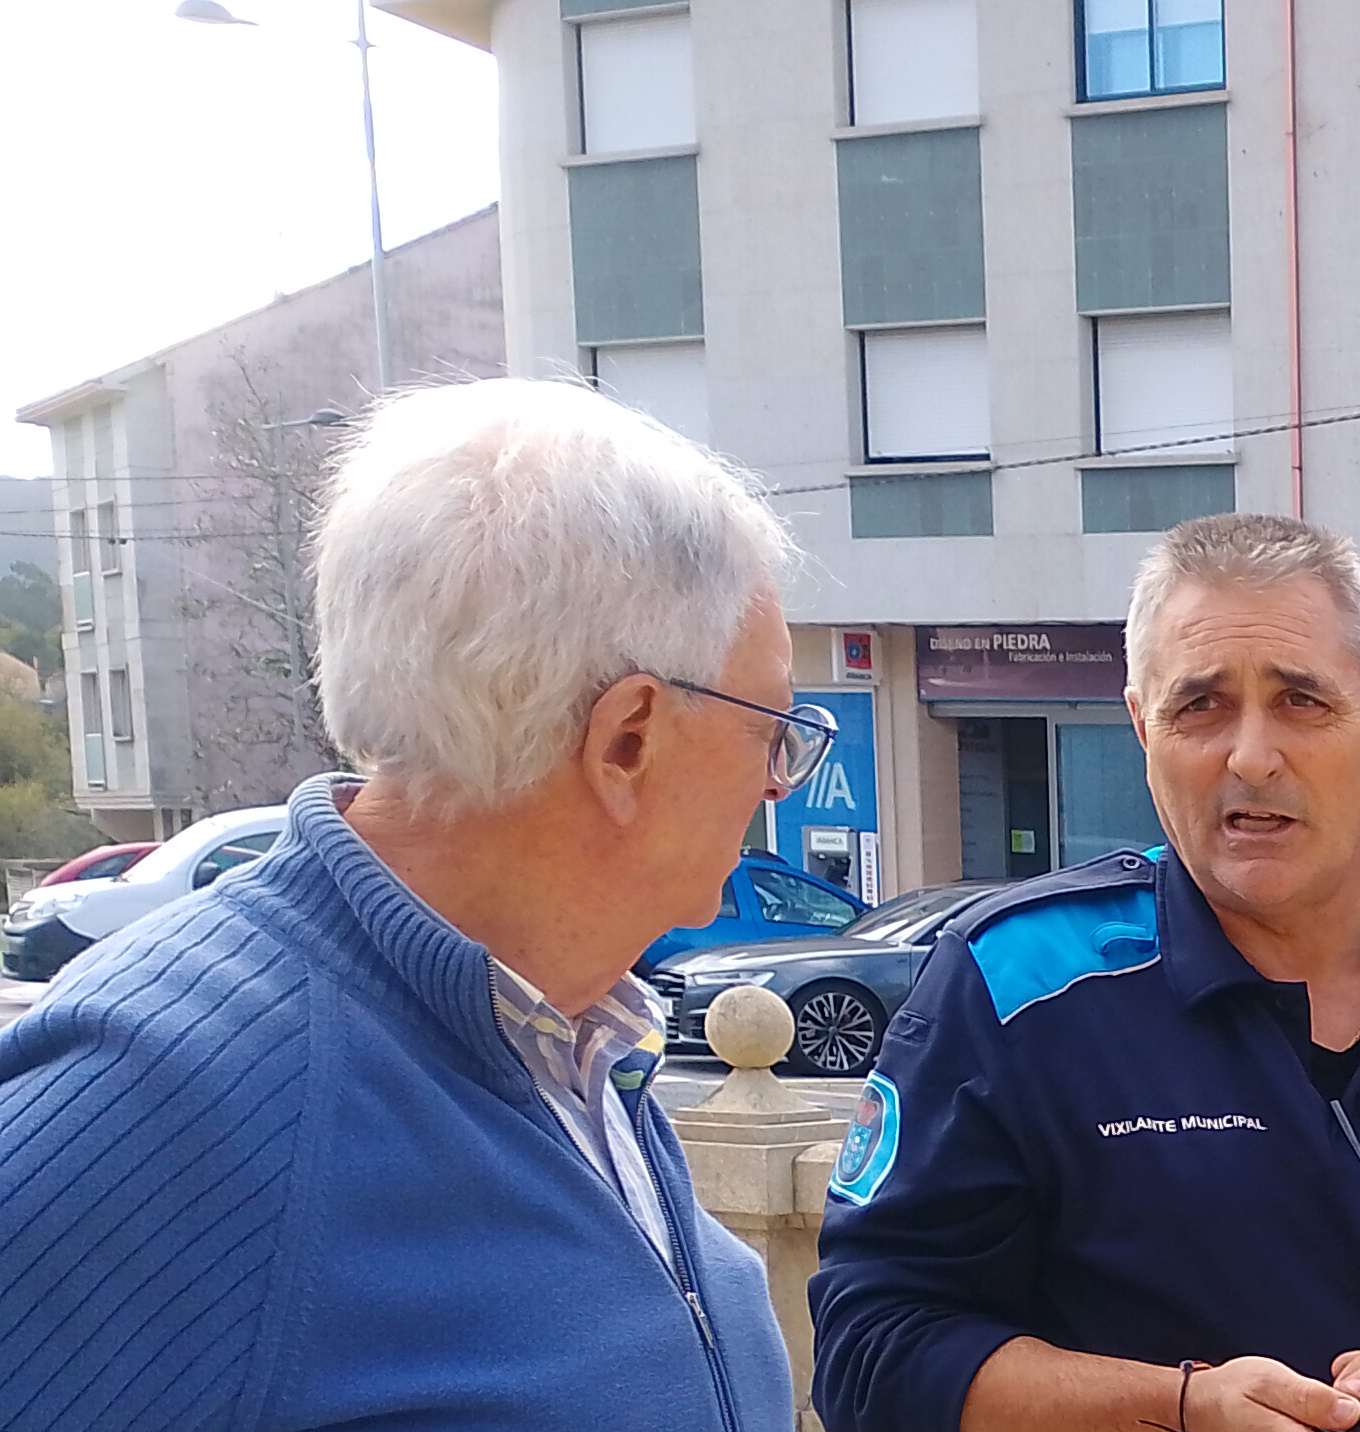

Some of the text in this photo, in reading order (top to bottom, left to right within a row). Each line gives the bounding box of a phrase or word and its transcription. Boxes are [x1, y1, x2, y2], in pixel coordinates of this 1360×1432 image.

[993, 633, 1050, 650] PIEDRA
[1098, 1115, 1268, 1137] VIXILANTE MUNICIPAL
